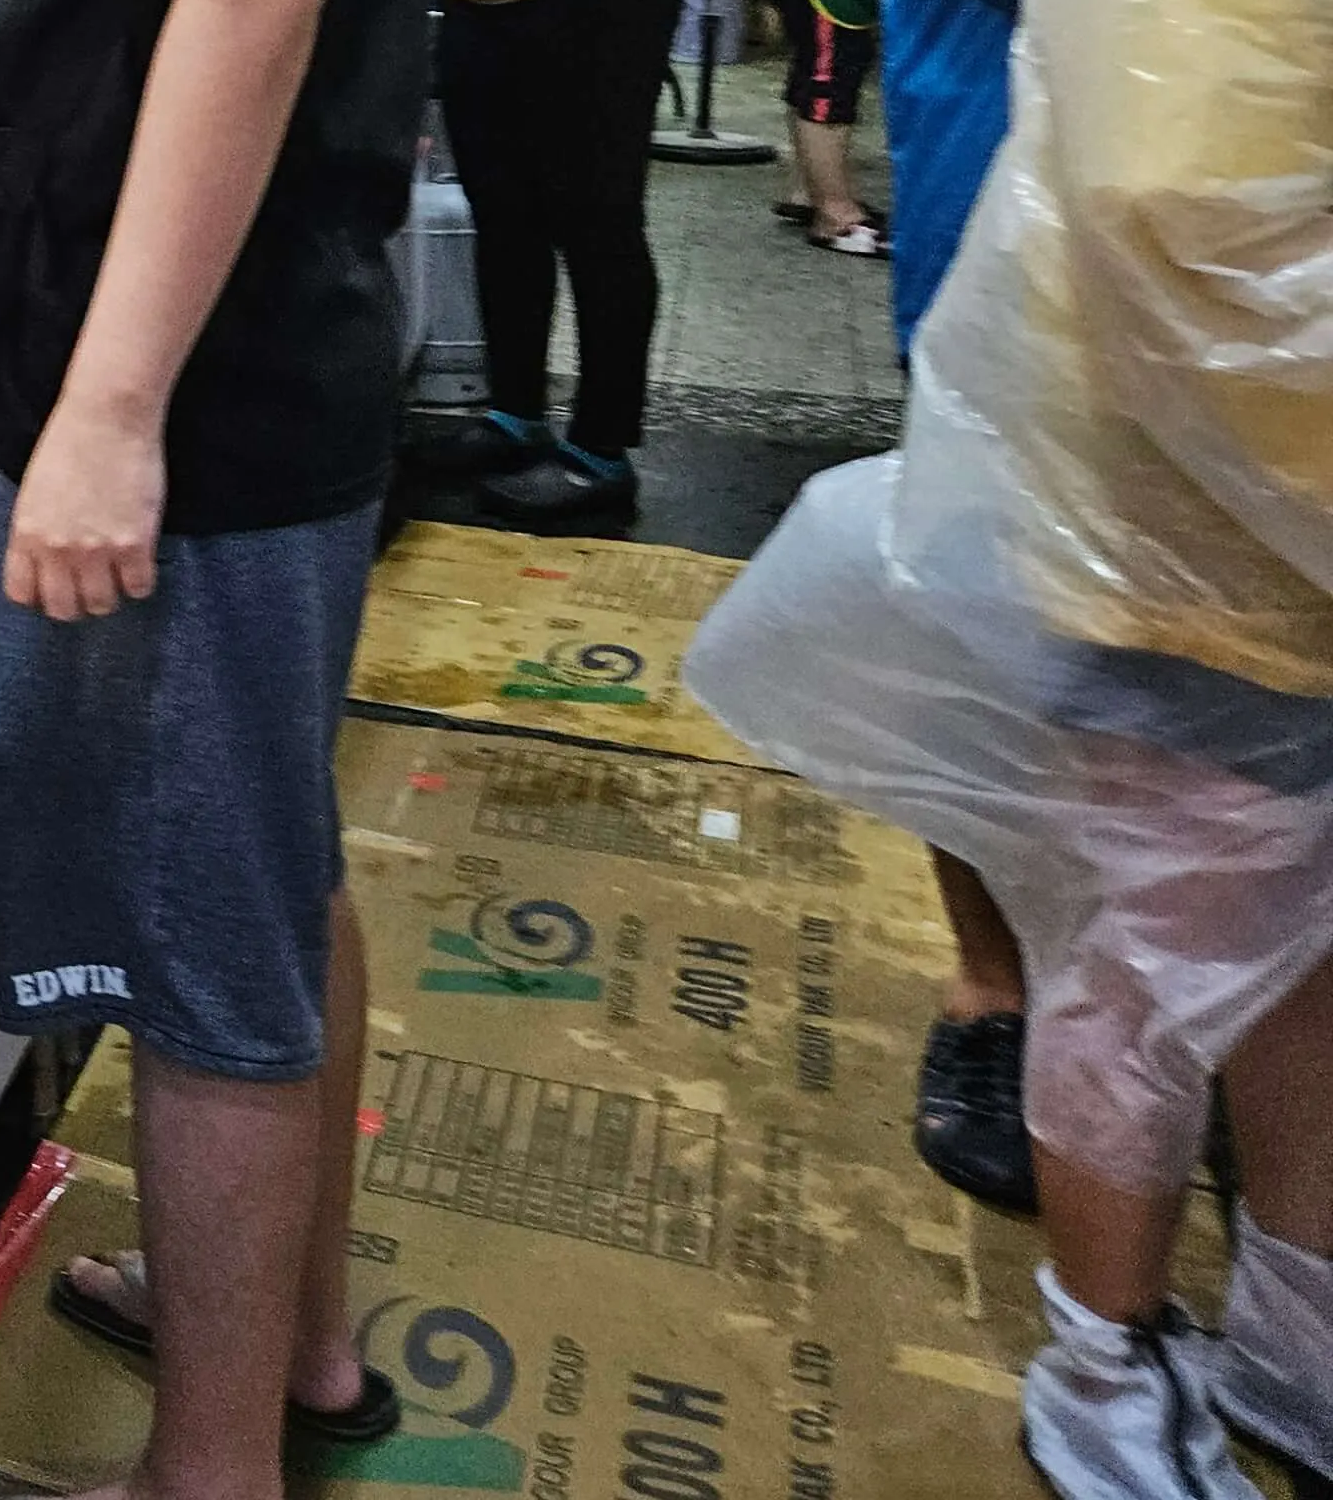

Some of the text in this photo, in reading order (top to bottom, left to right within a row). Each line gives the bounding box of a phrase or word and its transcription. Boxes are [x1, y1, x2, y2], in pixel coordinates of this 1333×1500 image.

[10, 963, 134, 1007] EDWIN
[671, 935, 754, 1031] 400 H
[540, 1333, 591, 1417] GROUP
[789, 1339, 837, 1389] LTD
[626, 1371, 729, 1431] H
